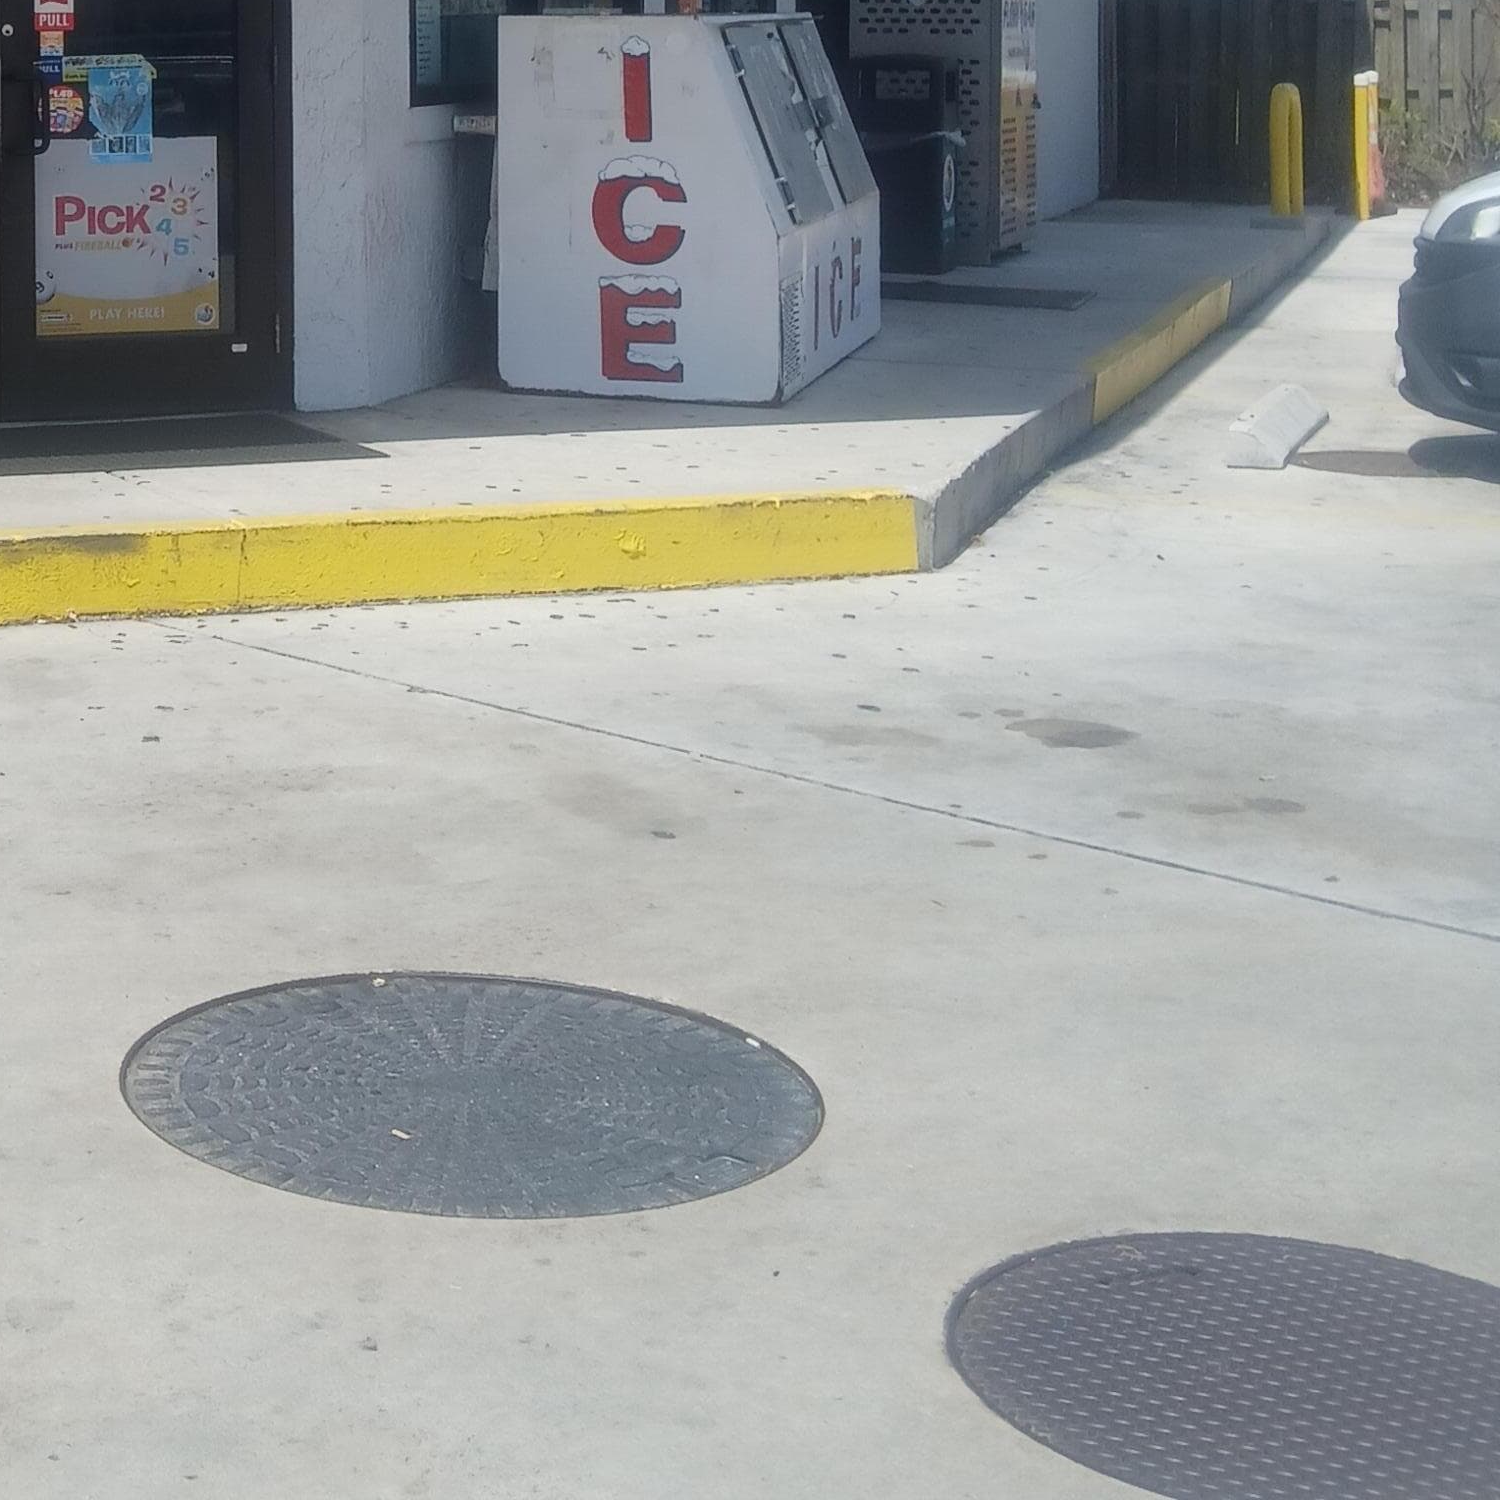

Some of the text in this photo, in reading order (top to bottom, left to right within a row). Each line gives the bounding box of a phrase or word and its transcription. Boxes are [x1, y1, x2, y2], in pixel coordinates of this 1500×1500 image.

[40, 14, 70, 27] PULL
[150, 184, 167, 202] 2
[171, 198, 189, 216] 3
[591, 35, 687, 383] ICE
[156, 218, 172, 236] 4
[173, 238, 190, 256] 5
[89, 307, 165, 321] PLAY HERE!
